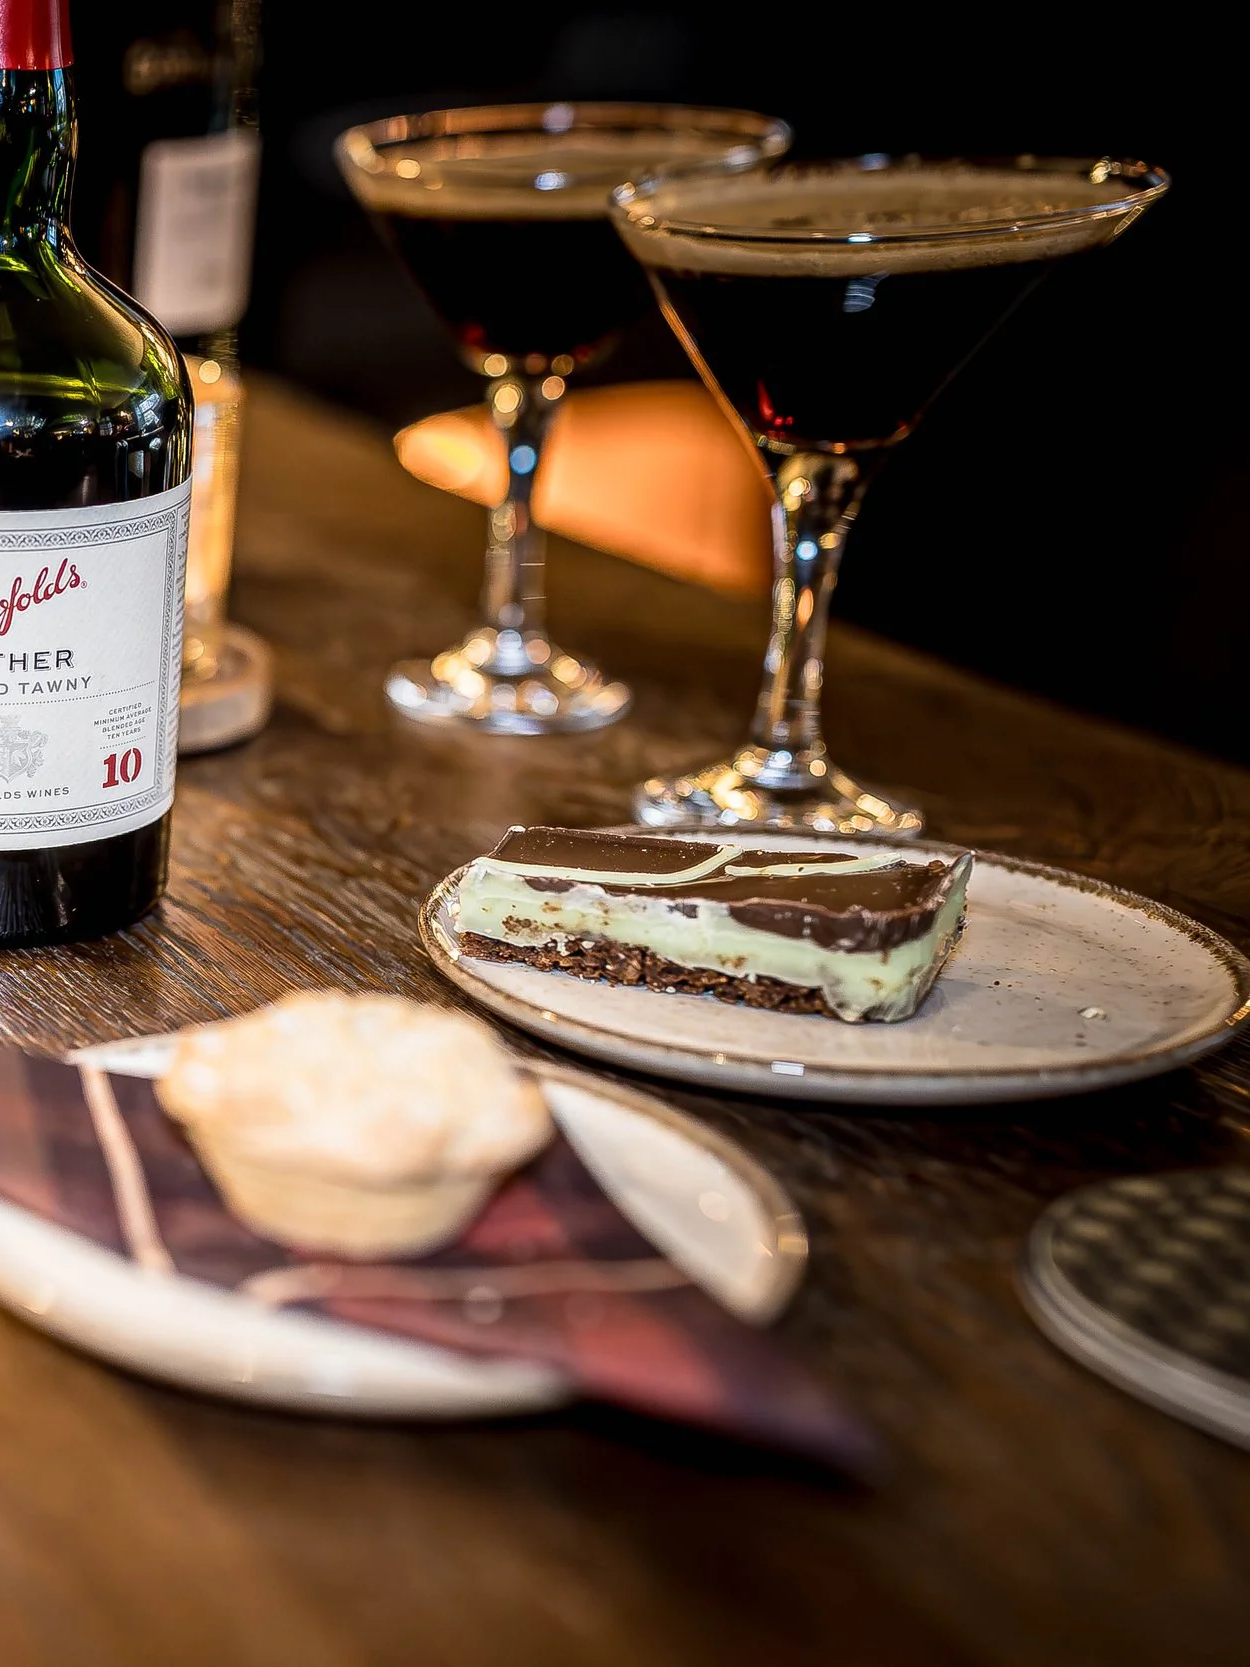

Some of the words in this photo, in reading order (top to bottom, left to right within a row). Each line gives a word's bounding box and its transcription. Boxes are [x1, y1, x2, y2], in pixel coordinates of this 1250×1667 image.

[18, 675, 92, 695] TAWNY
[93, 715, 125, 727] MINIMUM
[126, 706, 152, 720] AVERAGE
[108, 702, 142, 716] CERTIFIED
[102, 721, 133, 733] BLENDED
[134, 716, 146, 725] AGE
[107, 731, 121, 740] TEN
[122, 726, 142, 737] YEARS
[102, 747, 142, 789] 10
[27, 786, 70, 799] WINES
